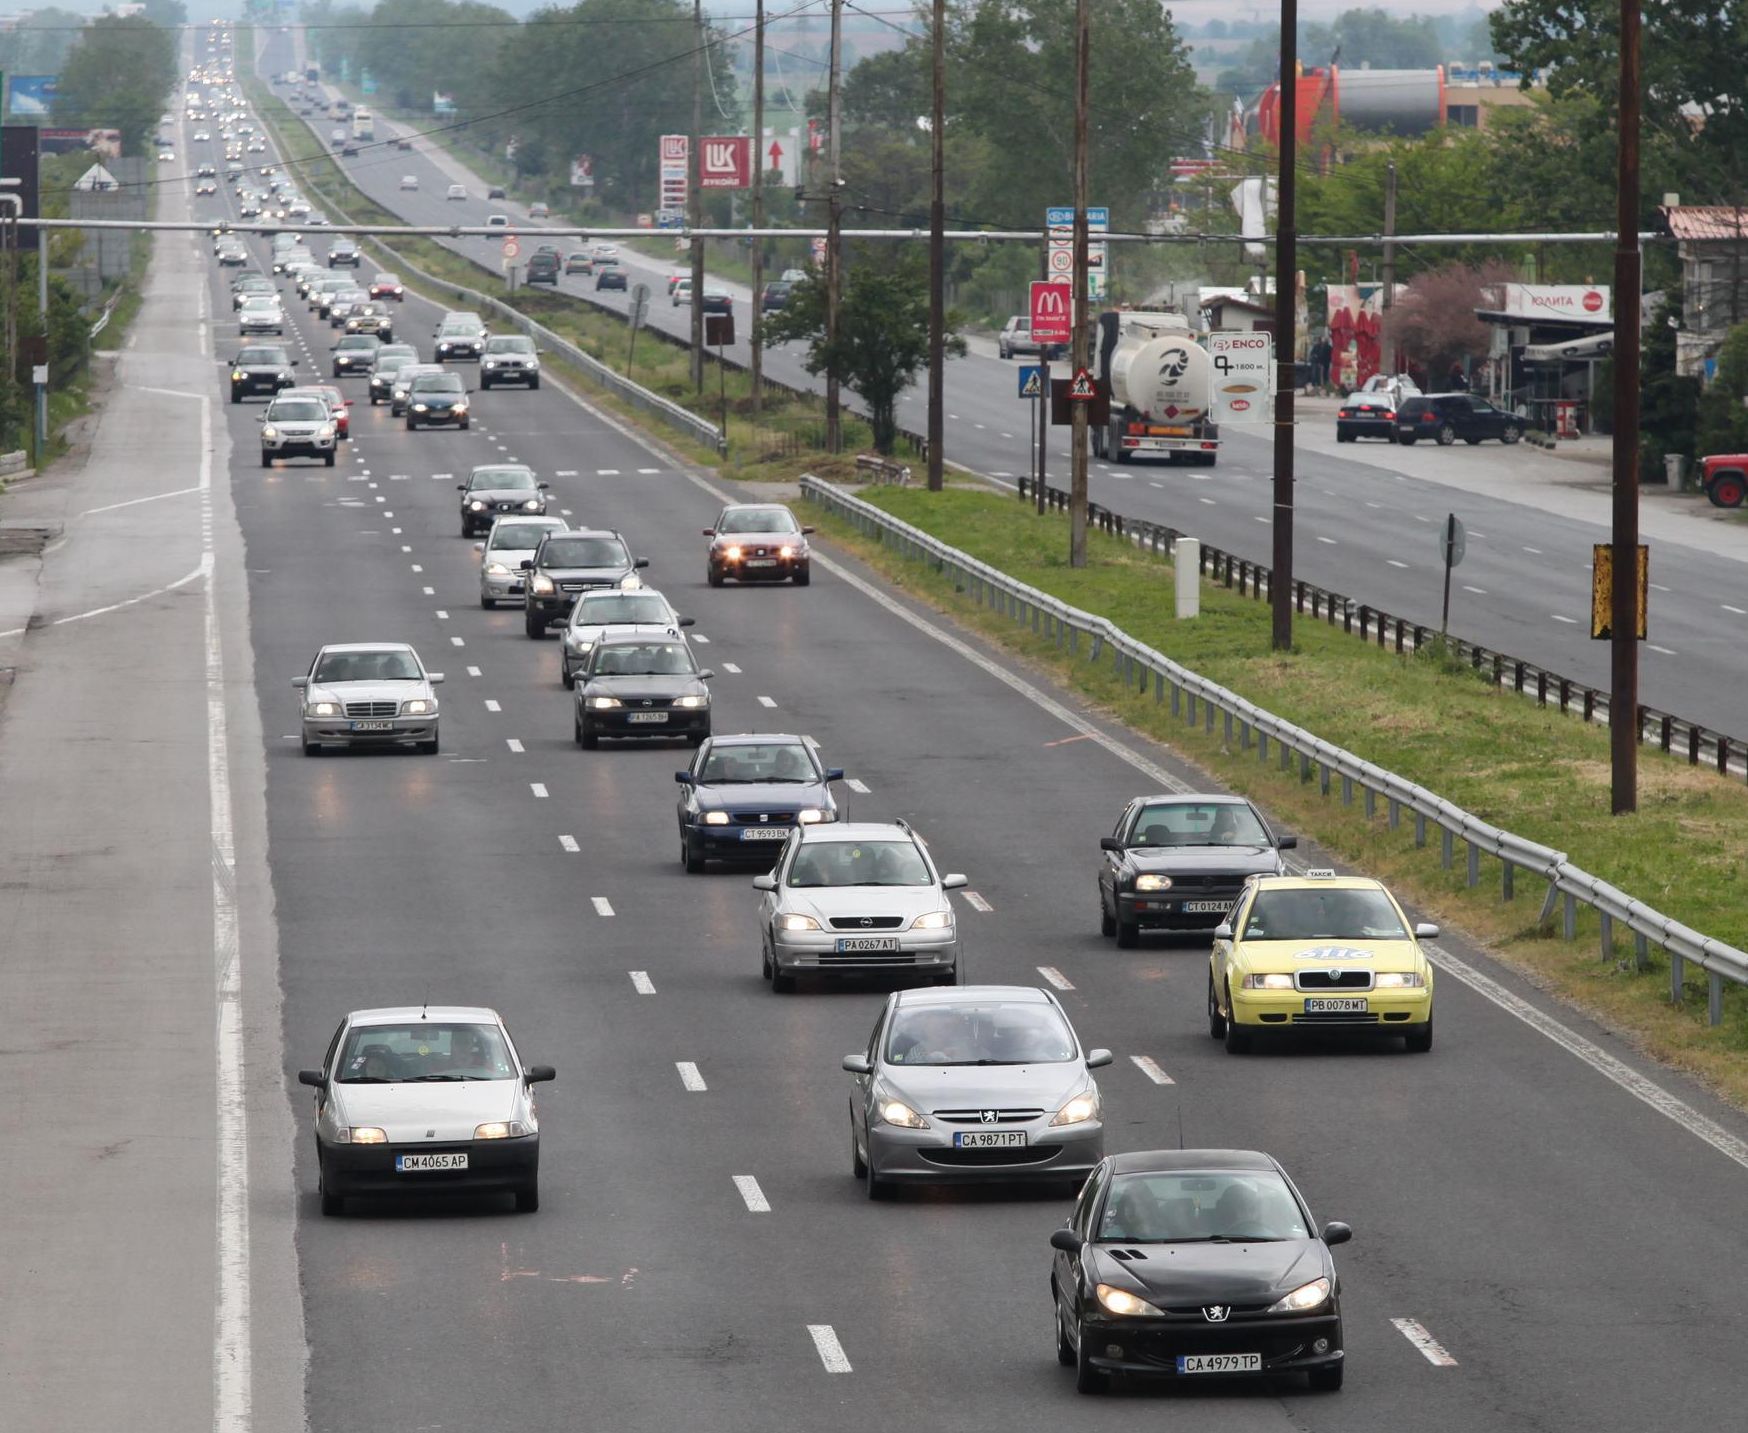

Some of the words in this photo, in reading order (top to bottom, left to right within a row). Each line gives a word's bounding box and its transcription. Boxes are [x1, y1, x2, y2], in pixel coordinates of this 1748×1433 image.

[1532, 296, 1574, 306] ЮЛИТА
[1232, 339, 1264, 349] ENCO
[745, 830, 756, 839] CT
[757, 830, 776, 838] 9593
[1188, 902, 1199, 911] CT
[1200, 902, 1222, 911] 0124
[845, 941, 857, 950] PA
[858, 940, 880, 950] 0267
[882, 940, 894, 949] AT
[1311, 1001, 1325, 1010] PB
[1326, 1001, 1351, 1010] 0078
[1352, 1001, 1365, 1010] MT
[962, 1135, 978, 1146] CA
[979, 1134, 1006, 1146] 9871
[1008, 1133, 1024, 1145] PT
[404, 1157, 420, 1169] CM
[421, 1156, 449, 1168] 4065
[451, 1155, 466, 1167] AP
[1186, 1357, 1204, 1371] CA
[1206, 1356, 1239, 1370] 4979
[1241, 1355, 1259, 1369] TP
